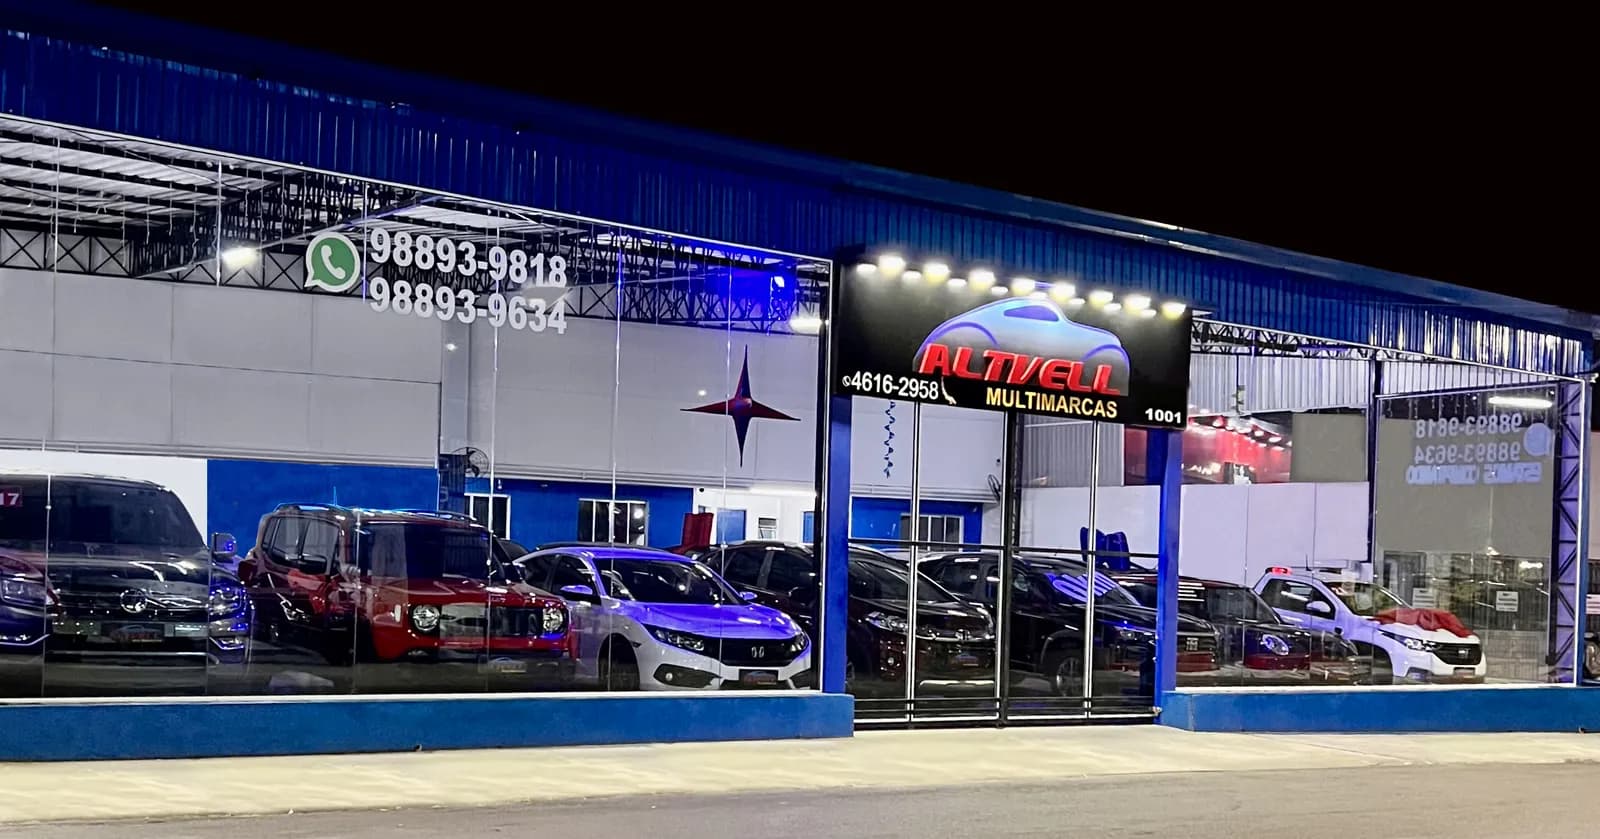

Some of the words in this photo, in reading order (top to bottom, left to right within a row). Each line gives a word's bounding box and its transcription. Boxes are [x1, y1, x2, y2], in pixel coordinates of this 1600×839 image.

[370, 227, 567, 288] 98893-9818
[369, 276, 567, 335] 98893-9634
[851, 370, 939, 400] 4616-2958
[986, 386, 1118, 419] MULTIMARCAS
[1144, 407, 1181, 424] 1001
